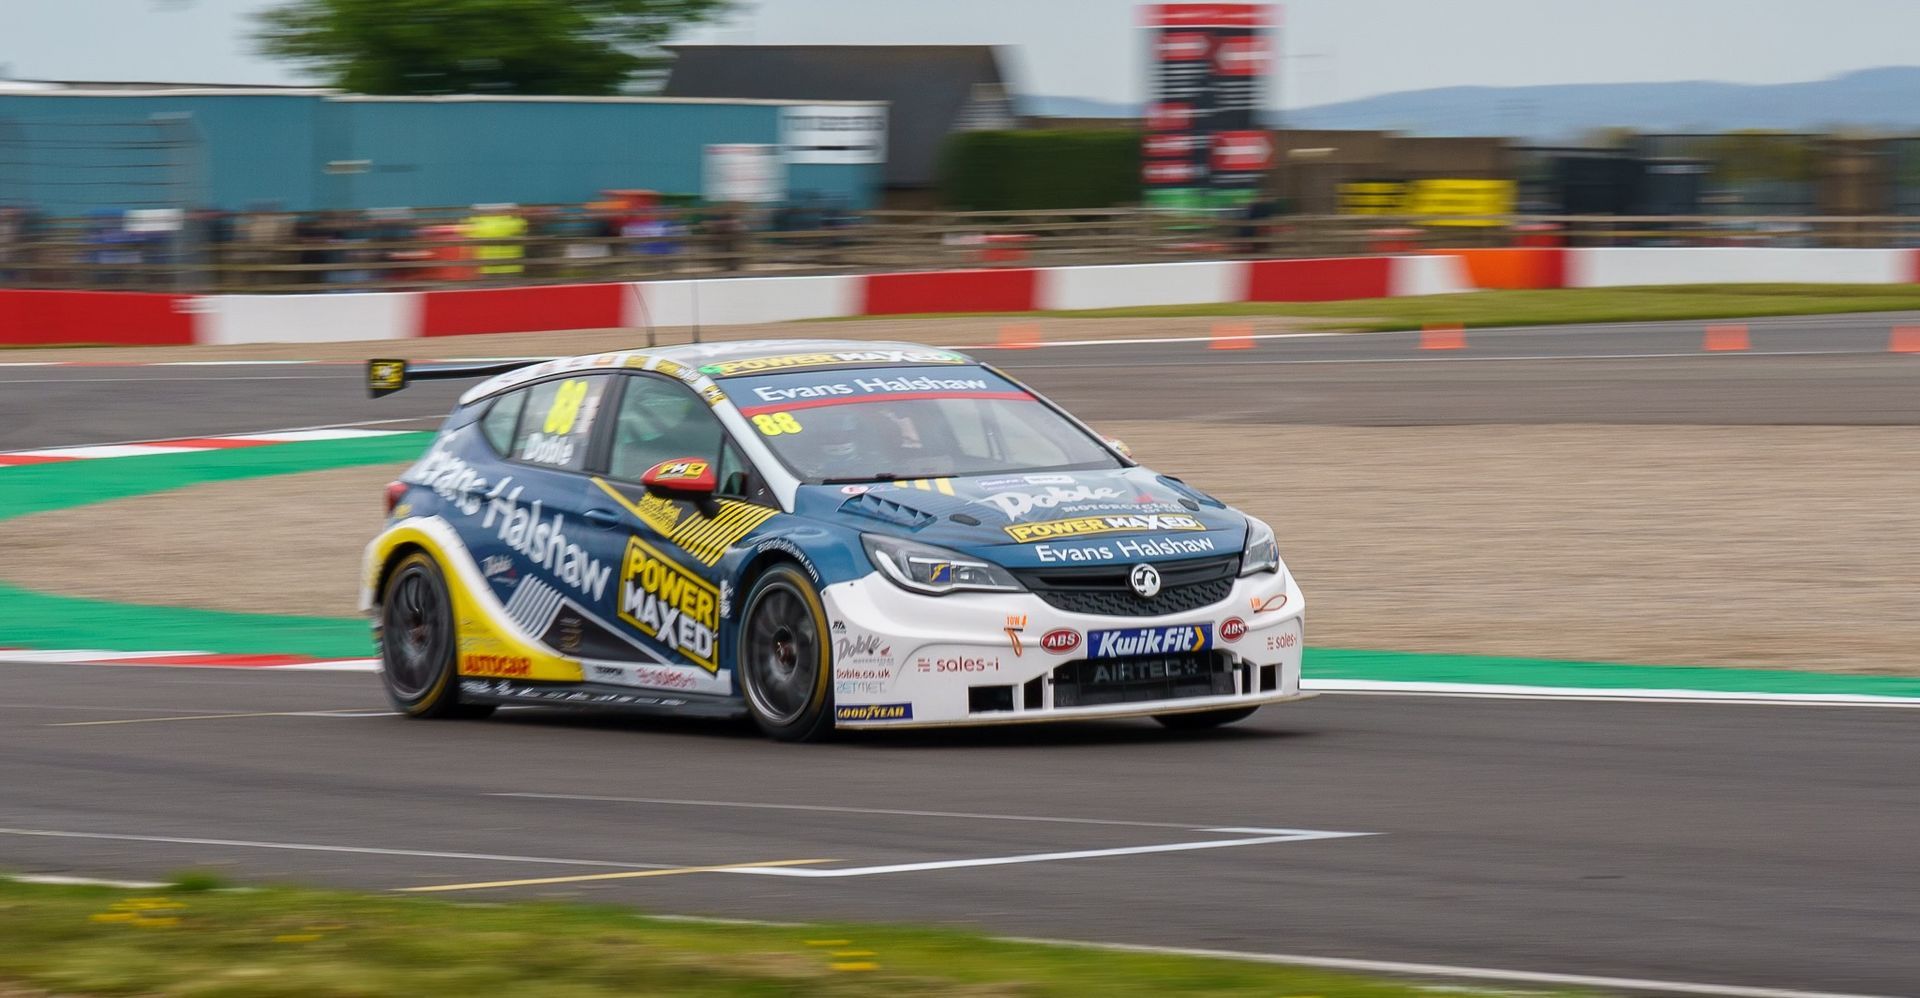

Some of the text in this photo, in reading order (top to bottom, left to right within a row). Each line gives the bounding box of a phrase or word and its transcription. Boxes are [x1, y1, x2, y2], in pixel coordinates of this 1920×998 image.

[751, 376, 989, 402] Evans Halshaw
[752, 411, 803, 436] 88
[963, 484, 1127, 522] Doble
[481, 475, 613, 602] Halshaw
[1011, 514, 1198, 540] POWER MAXED
[1035, 535, 1215, 562] Evans Halshaw
[627, 546, 714, 629] POWER
[623, 580, 714, 660] MAXED
[1223, 623, 1246, 636] ABS
[1047, 632, 1076, 647] ABS
[463, 654, 532, 677] AUTOCAR
[937, 656, 999, 672] sales-i
[1094, 660, 1182, 683] AIRTEC
[837, 704, 904, 720] GOODYEAR
